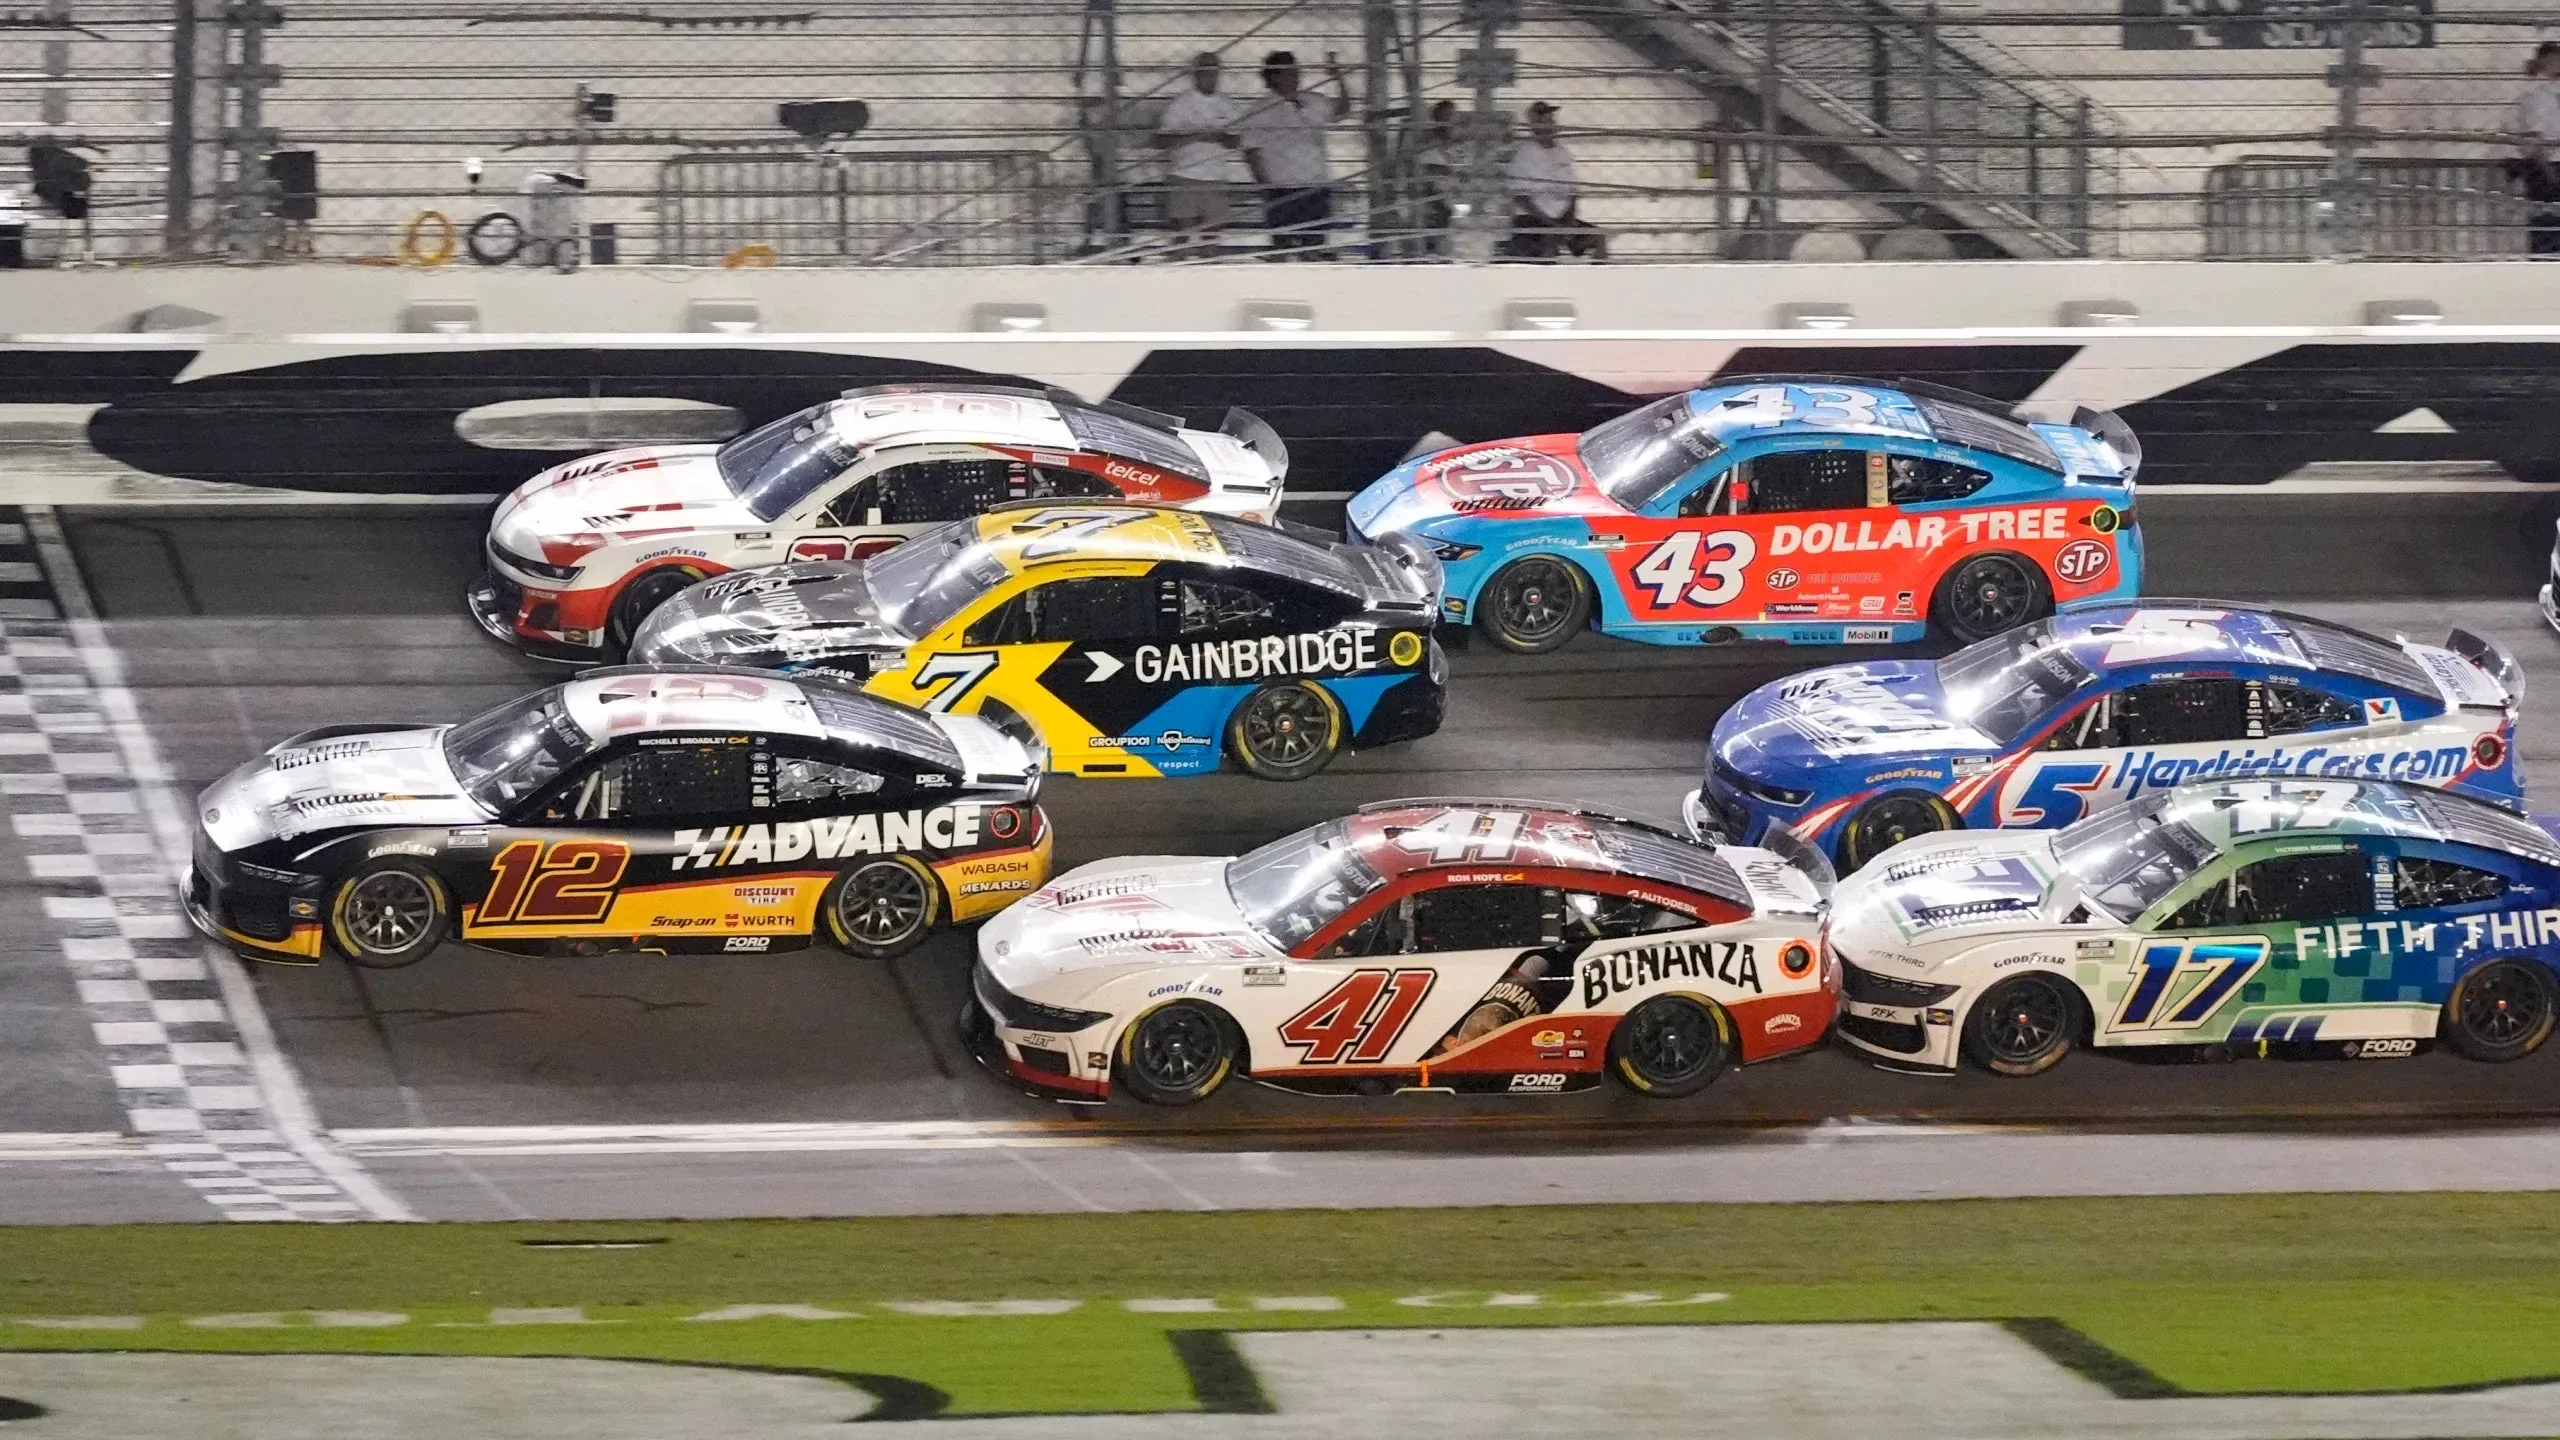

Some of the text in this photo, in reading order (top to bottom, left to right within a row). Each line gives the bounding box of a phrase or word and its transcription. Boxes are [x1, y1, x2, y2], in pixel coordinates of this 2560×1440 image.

[1706, 385, 1880, 429] 43
[1104, 461, 1160, 485] telcel
[1770, 507, 2068, 555] DOLLAR TREE
[1506, 535, 1579, 551] GOODYEAR
[636, 547, 707, 563] GOODYEAR
[2058, 544, 2105, 579] STP
[1630, 530, 1756, 610] 43
[1768, 570, 1798, 588] STP
[1776, 605, 1819, 613] WorkMoney
[1847, 631, 1877, 640] Mobil
[1134, 630, 1377, 683] GAINBRIDGE
[2040, 653, 2074, 683] LARSON
[911, 650, 999, 713] 7
[639, 736, 727, 746] MICHELE BROADLEY
[1090, 737, 1150, 747] GROUP1001
[916, 774, 946, 784] DEX
[1865, 767, 1943, 784] GOODYEAR
[2113, 746, 2467, 800] HendrickCars.com
[2007, 762, 2111, 829] 5
[2230, 781, 2367, 836] 17
[733, 806, 981, 866] ADVANCE
[368, 840, 437, 858] GOODYEAR
[961, 862, 1029, 875] WABASH
[1448, 873, 1502, 882] RON HOPE
[476, 840, 631, 923] 12
[960, 880, 1030, 895] MENARDS
[734, 887, 795, 897] DISCOUNT
[1641, 892, 1698, 914] AUTODESK
[651, 915, 795, 928] Snap-on WÜRTH
[725, 937, 770, 947] FORD
[2295, 909, 2560, 961] FIFTH THIR
[1869, 950, 1926, 968] FIFTH THIRD
[1994, 952, 2066, 969] GOODYEAR
[1583, 941, 1763, 1009] BONANZA
[2105, 934, 2273, 1034] 17
[1481, 982, 1540, 1017] BONAN
[1277, 967, 1437, 1065] 41
[1765, 1014, 1801, 1032] BONANZA
[1871, 1008, 1897, 1020] RFK
[2361, 1039, 2416, 1054] FORD
[1510, 1074, 1567, 1086] FORD
